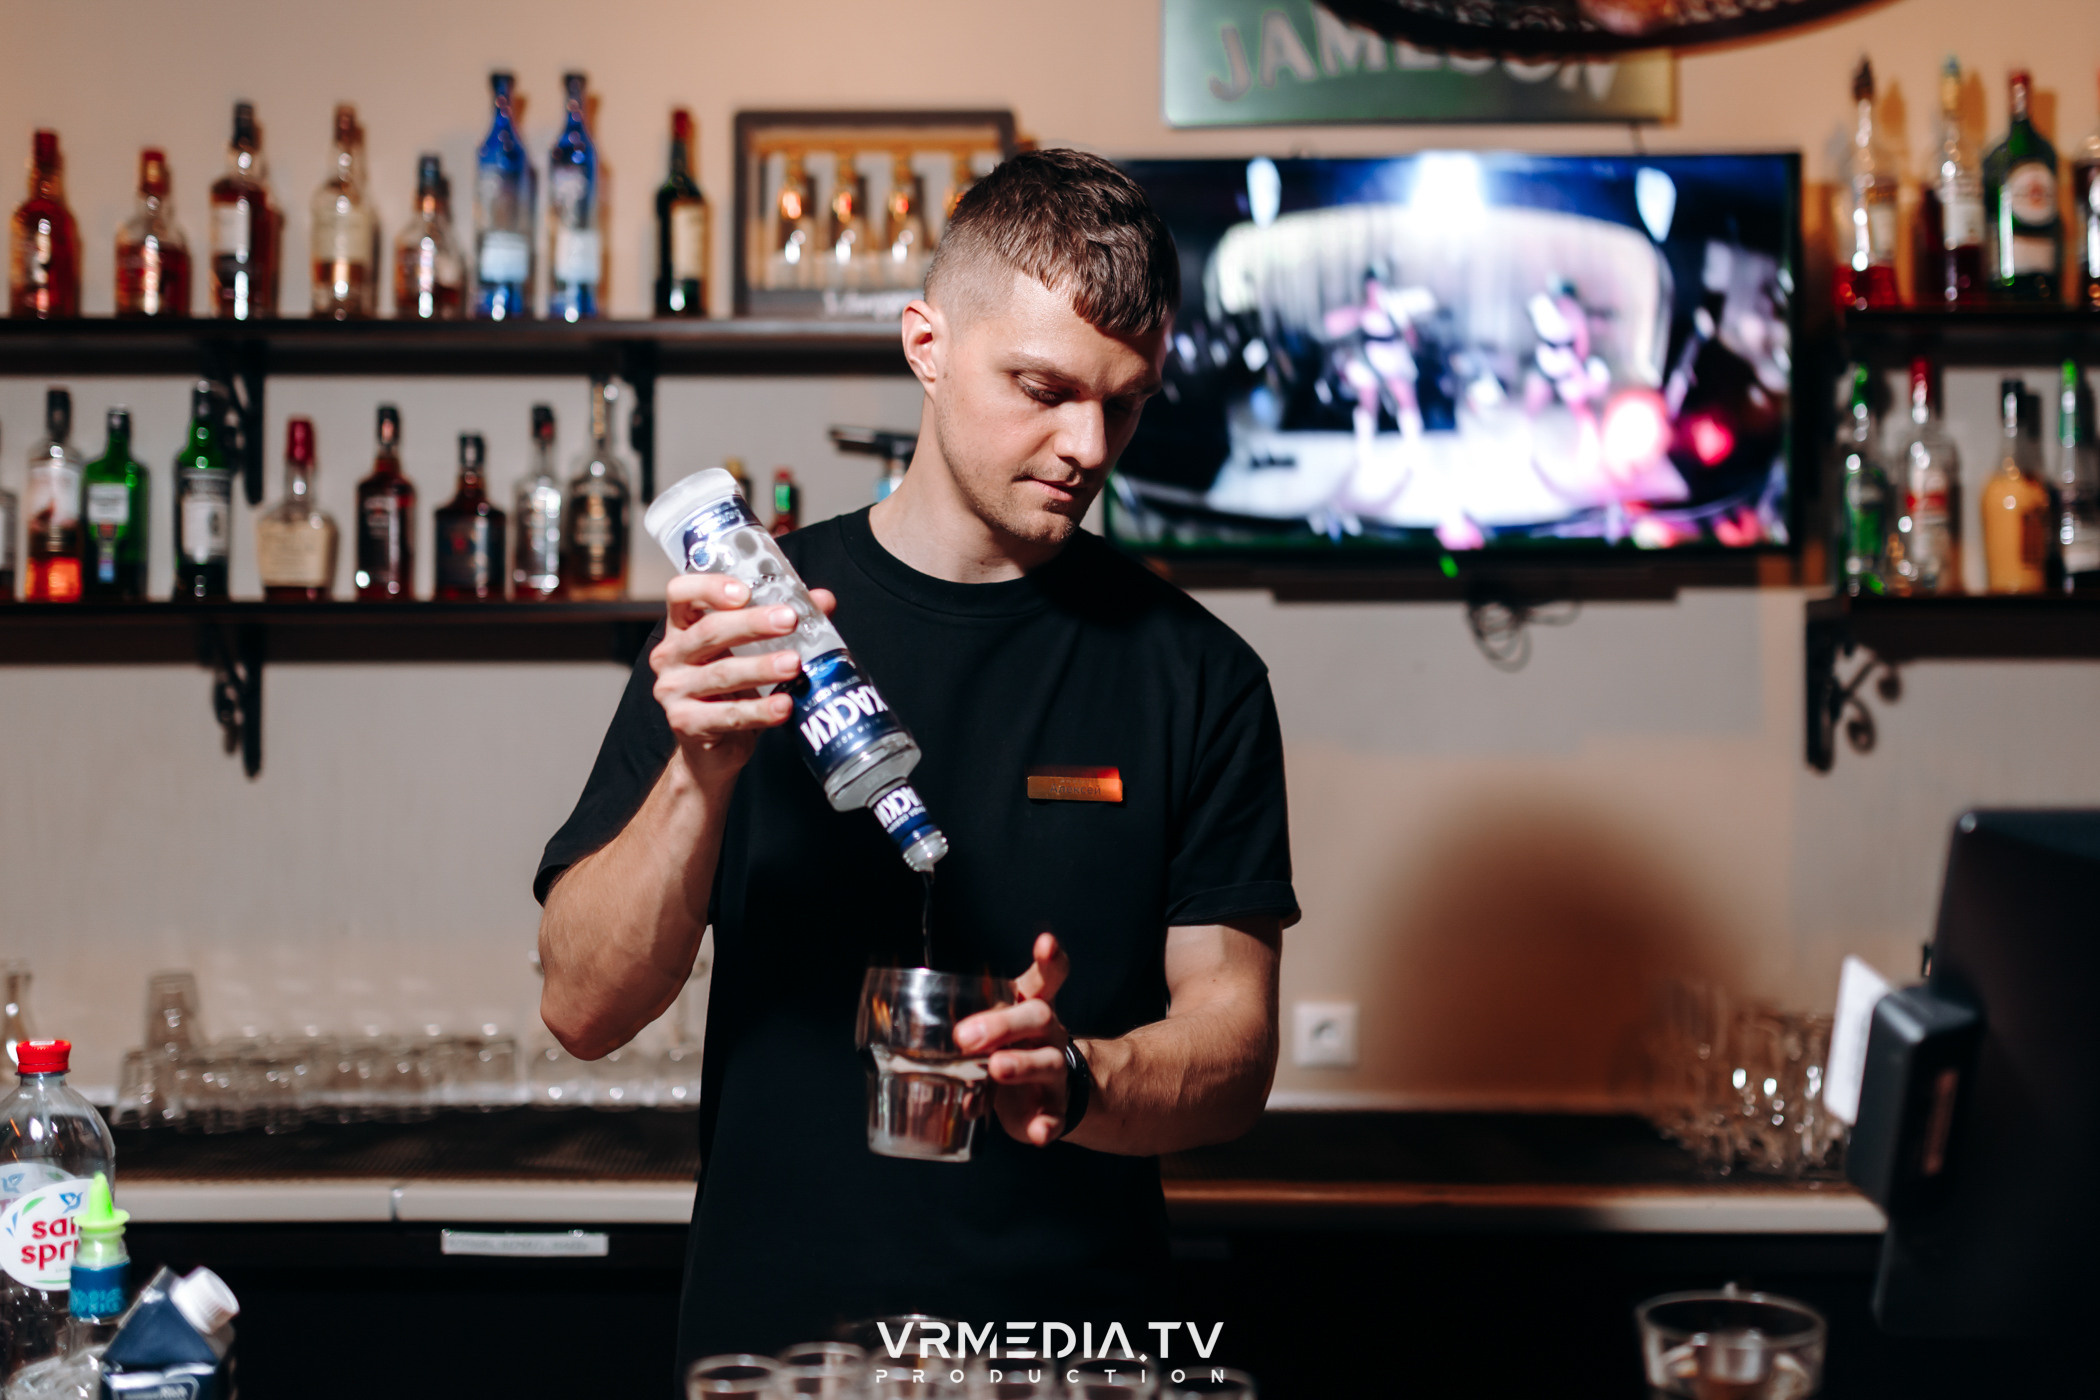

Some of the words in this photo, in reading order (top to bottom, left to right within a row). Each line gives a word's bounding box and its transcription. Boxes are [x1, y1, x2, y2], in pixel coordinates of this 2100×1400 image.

[800, 685, 889, 751] ХАСКИ
[874, 786, 924, 829] АСКИ
[1050, 783, 1101, 796] Алексей
